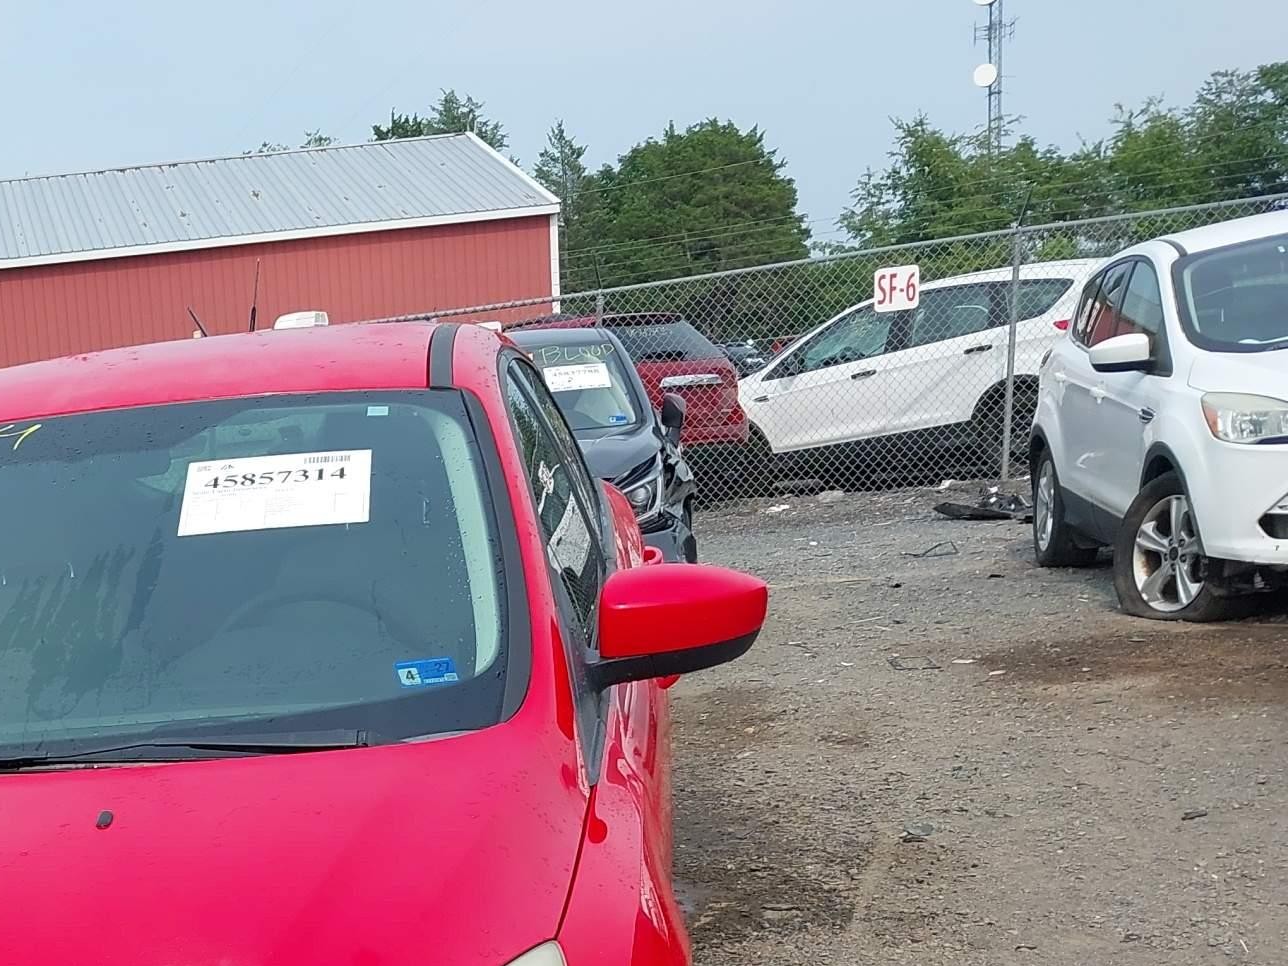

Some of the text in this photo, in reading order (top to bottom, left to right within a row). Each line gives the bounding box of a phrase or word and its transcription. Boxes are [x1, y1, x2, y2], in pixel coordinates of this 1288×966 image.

[877, 272, 916, 305] SF-6
[538, 343, 614, 365] BLOOD
[204, 466, 347, 489] 45857314
